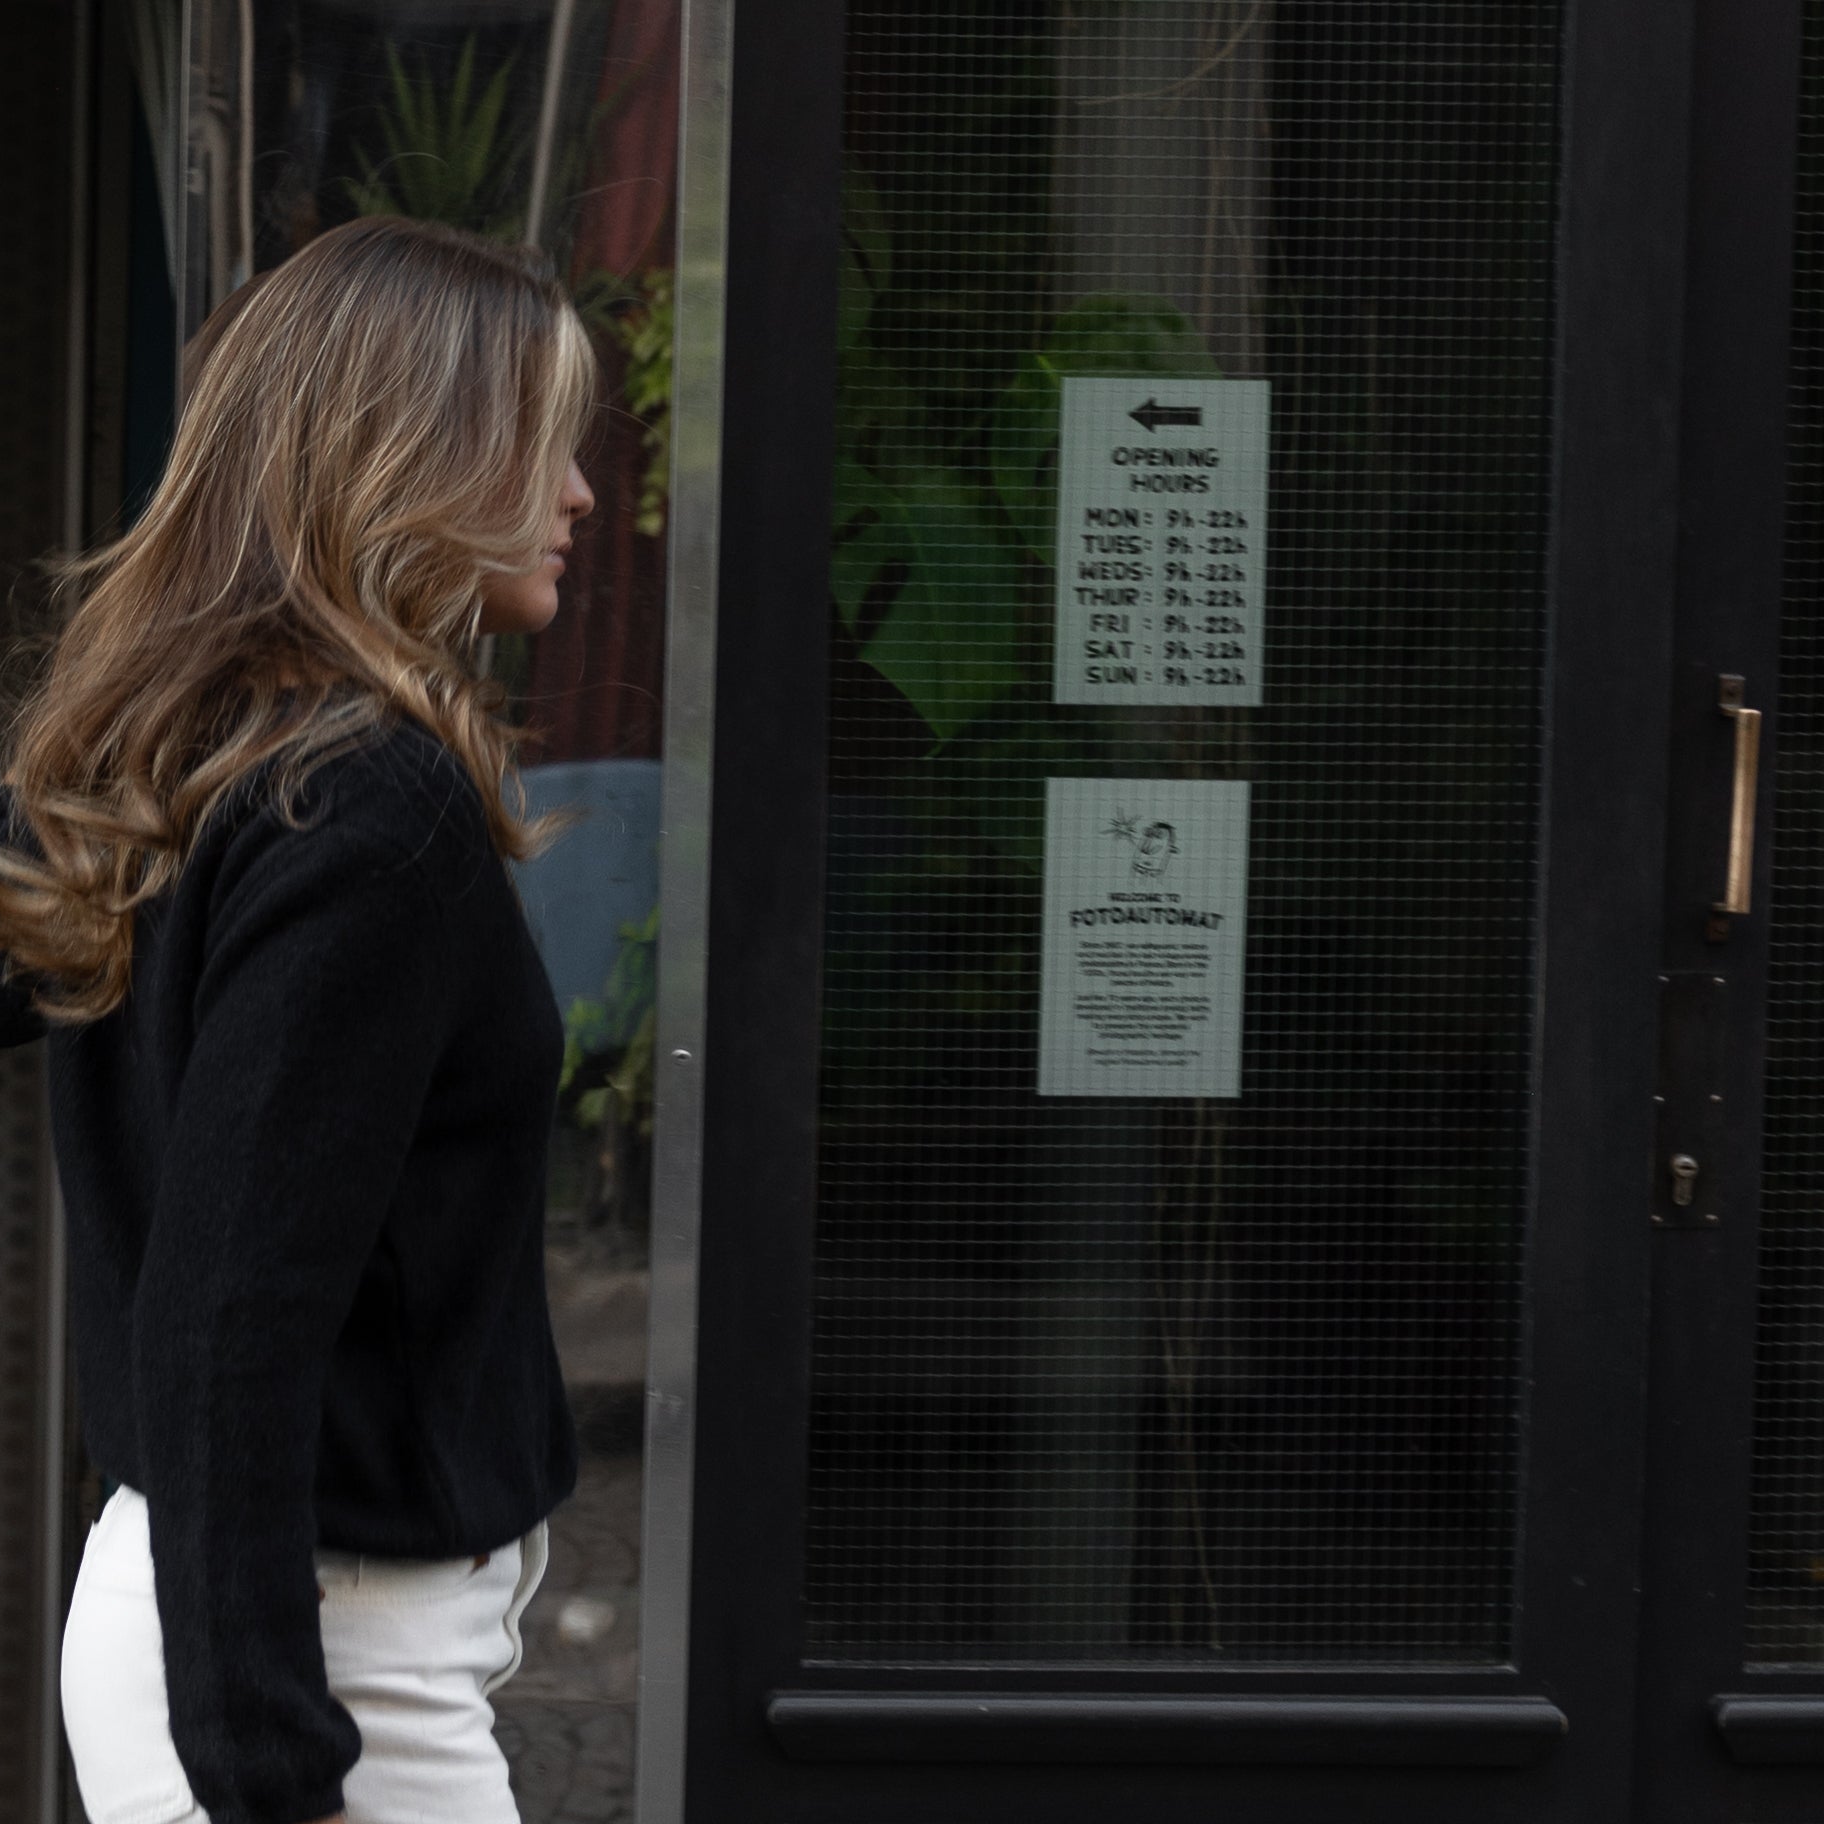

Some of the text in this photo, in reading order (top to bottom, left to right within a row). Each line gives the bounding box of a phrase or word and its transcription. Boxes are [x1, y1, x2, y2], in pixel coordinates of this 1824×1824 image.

[1112, 447, 1220, 468] OPENING
[1130, 474, 1211, 494] HOURS
[1069, 906, 1224, 929] FOTOAUTOMAT
